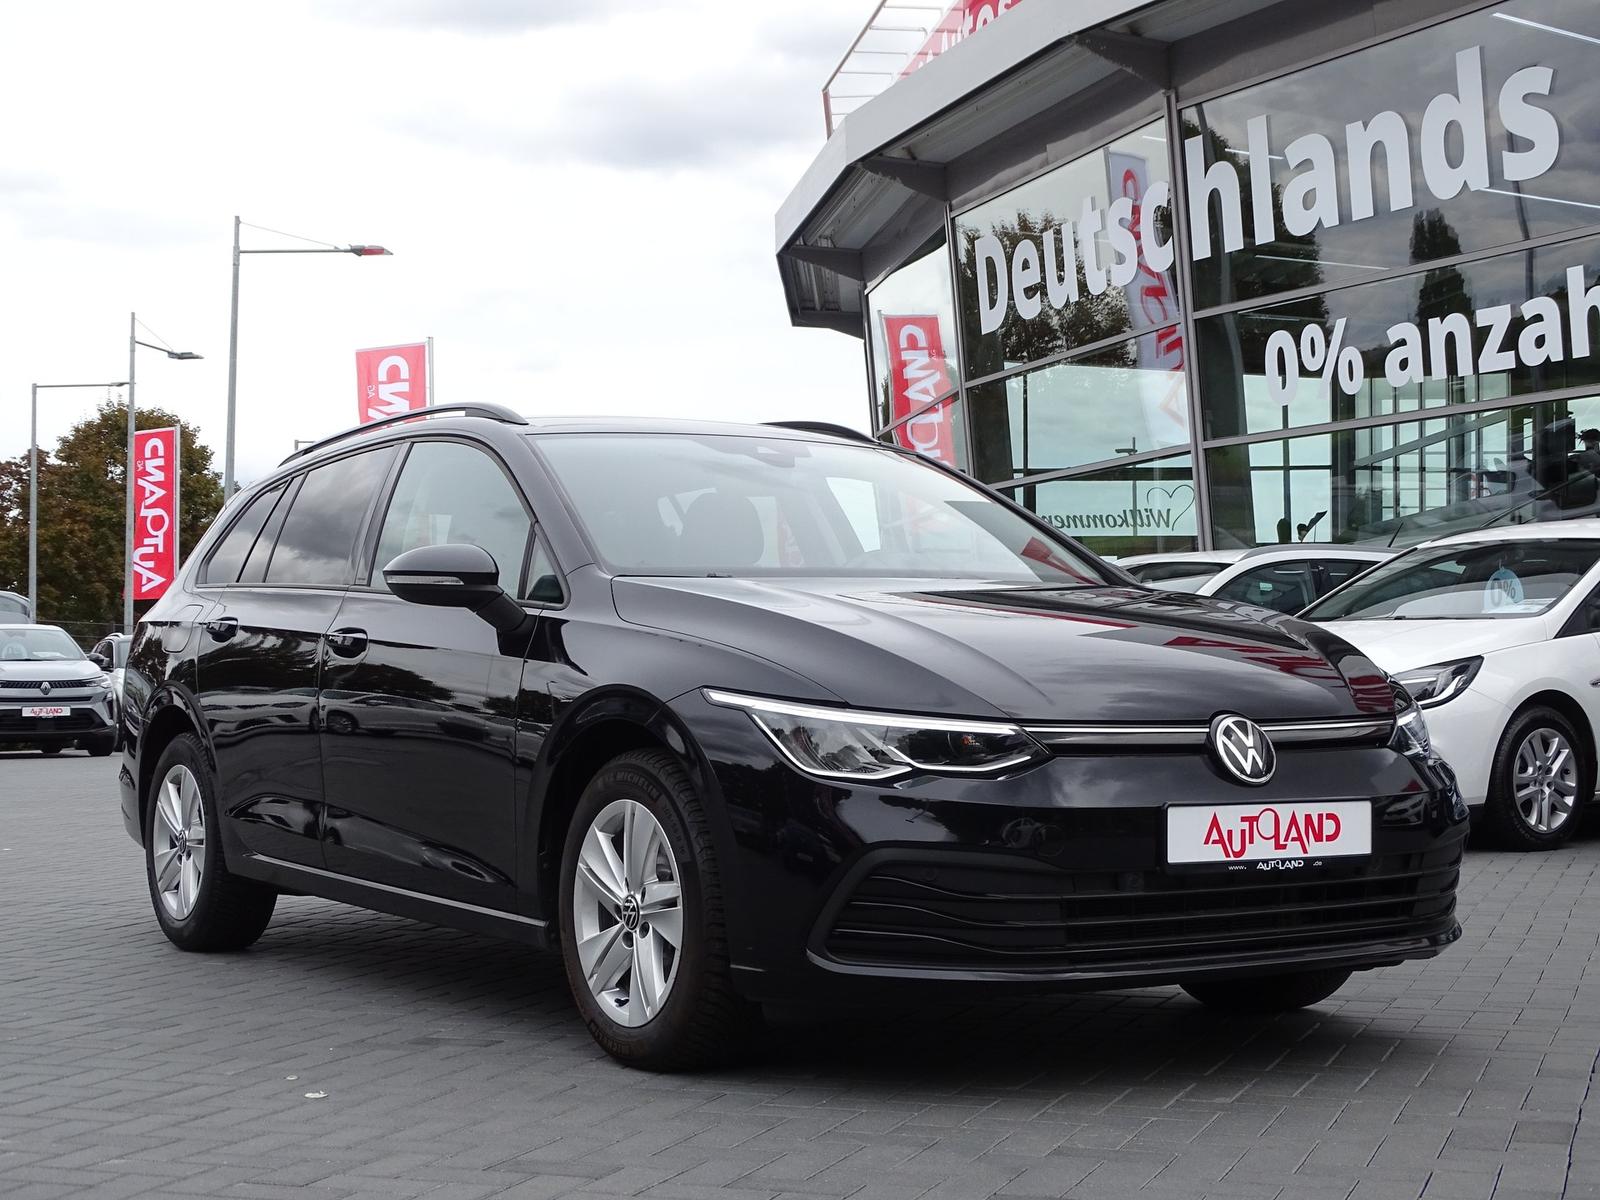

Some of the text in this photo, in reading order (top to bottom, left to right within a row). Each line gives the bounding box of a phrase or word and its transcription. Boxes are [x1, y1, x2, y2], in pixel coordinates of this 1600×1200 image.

[974, 45, 1560, 335] Deutschlands
[1265, 317, 1364, 406] 0%
[615, 771, 661, 800] MICHELIN
[1203, 808, 1341, 858] AUTOLAND
[1256, 860, 1304, 870] AUTOLAND
